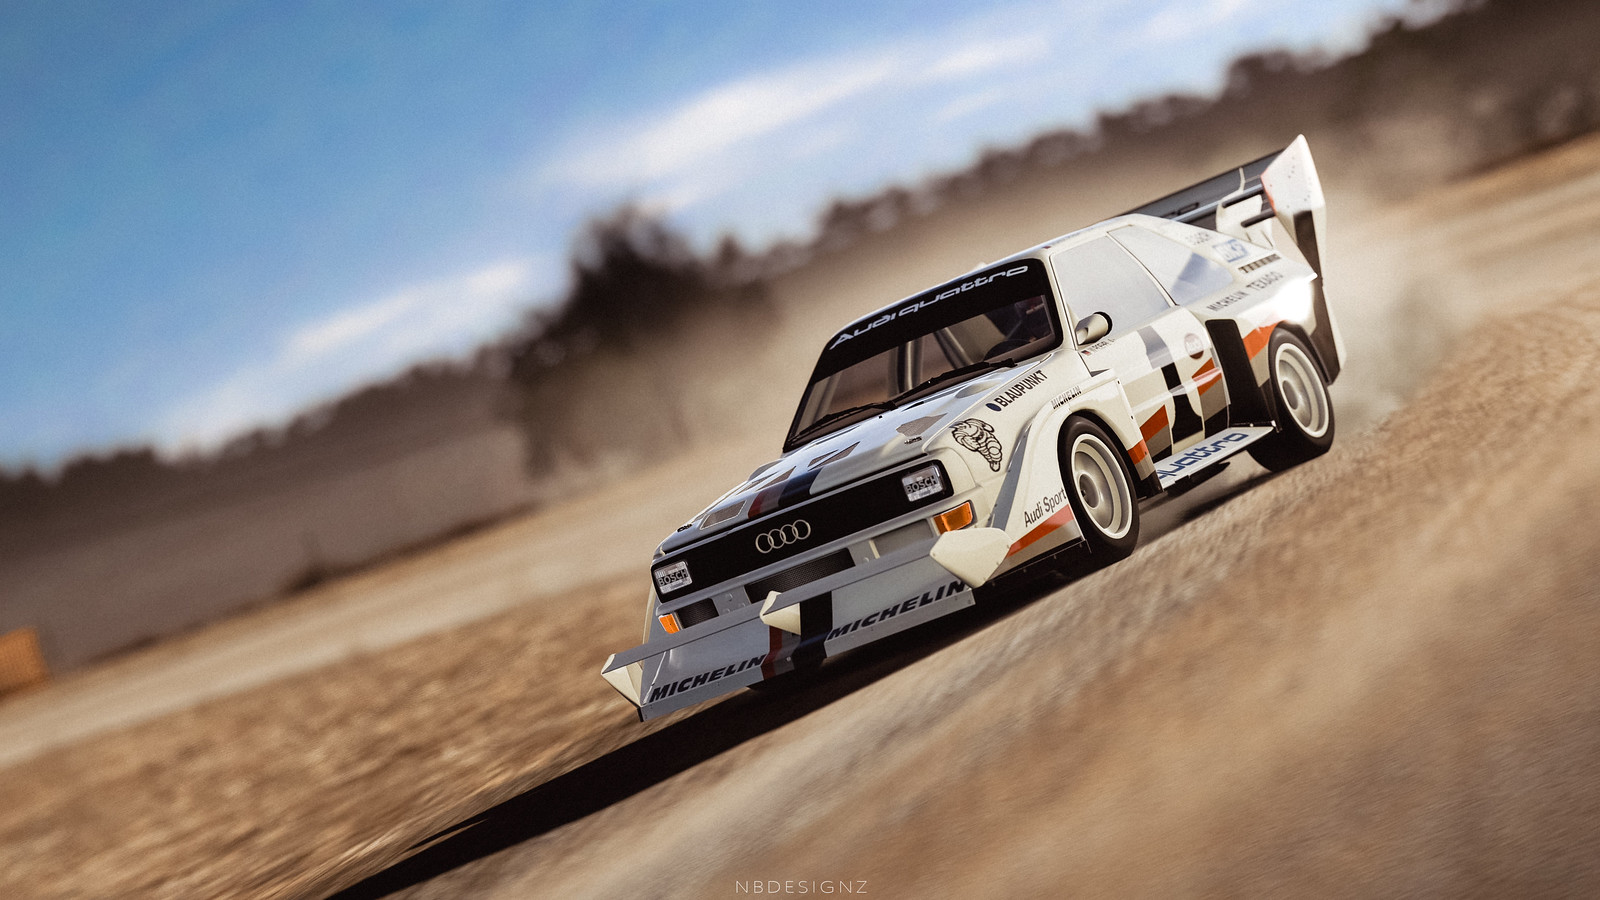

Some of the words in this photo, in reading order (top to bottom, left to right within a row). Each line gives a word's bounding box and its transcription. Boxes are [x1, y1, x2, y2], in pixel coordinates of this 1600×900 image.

[993, 369, 1048, 407] BLAUPUNKT
[1050, 386, 1082, 409] MICHELIN
[904, 475, 938, 493] BOSCH
[1023, 501, 1044, 528] Audi
[1042, 487, 1067, 513] Sport
[658, 568, 689, 587] BOSCH
[827, 580, 966, 641] MICHELIN
[649, 653, 767, 703] MICHELIN
